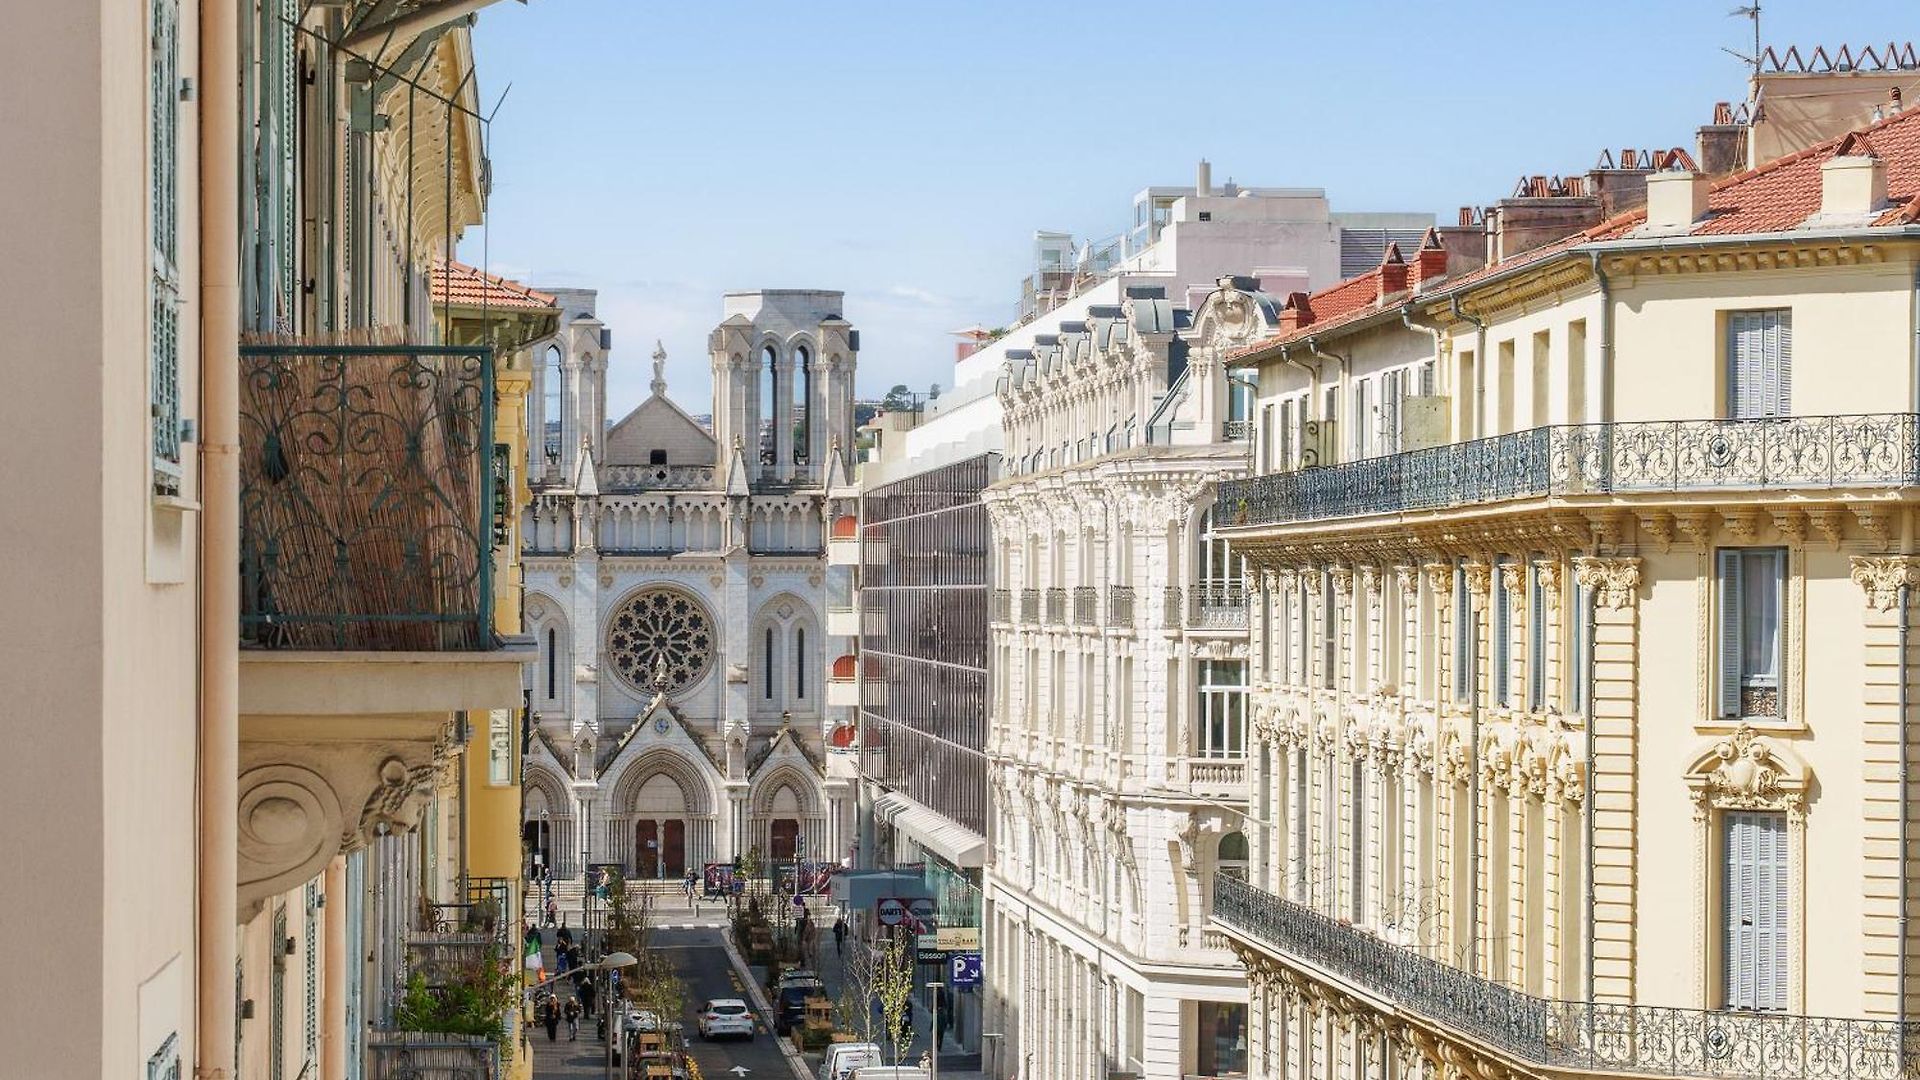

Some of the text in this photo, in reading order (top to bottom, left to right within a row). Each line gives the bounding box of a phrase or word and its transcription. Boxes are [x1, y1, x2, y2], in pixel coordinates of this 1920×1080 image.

[880, 908, 902, 916] DARTY
[918, 951, 947, 960] Besson
[953, 959, 966, 978] P
